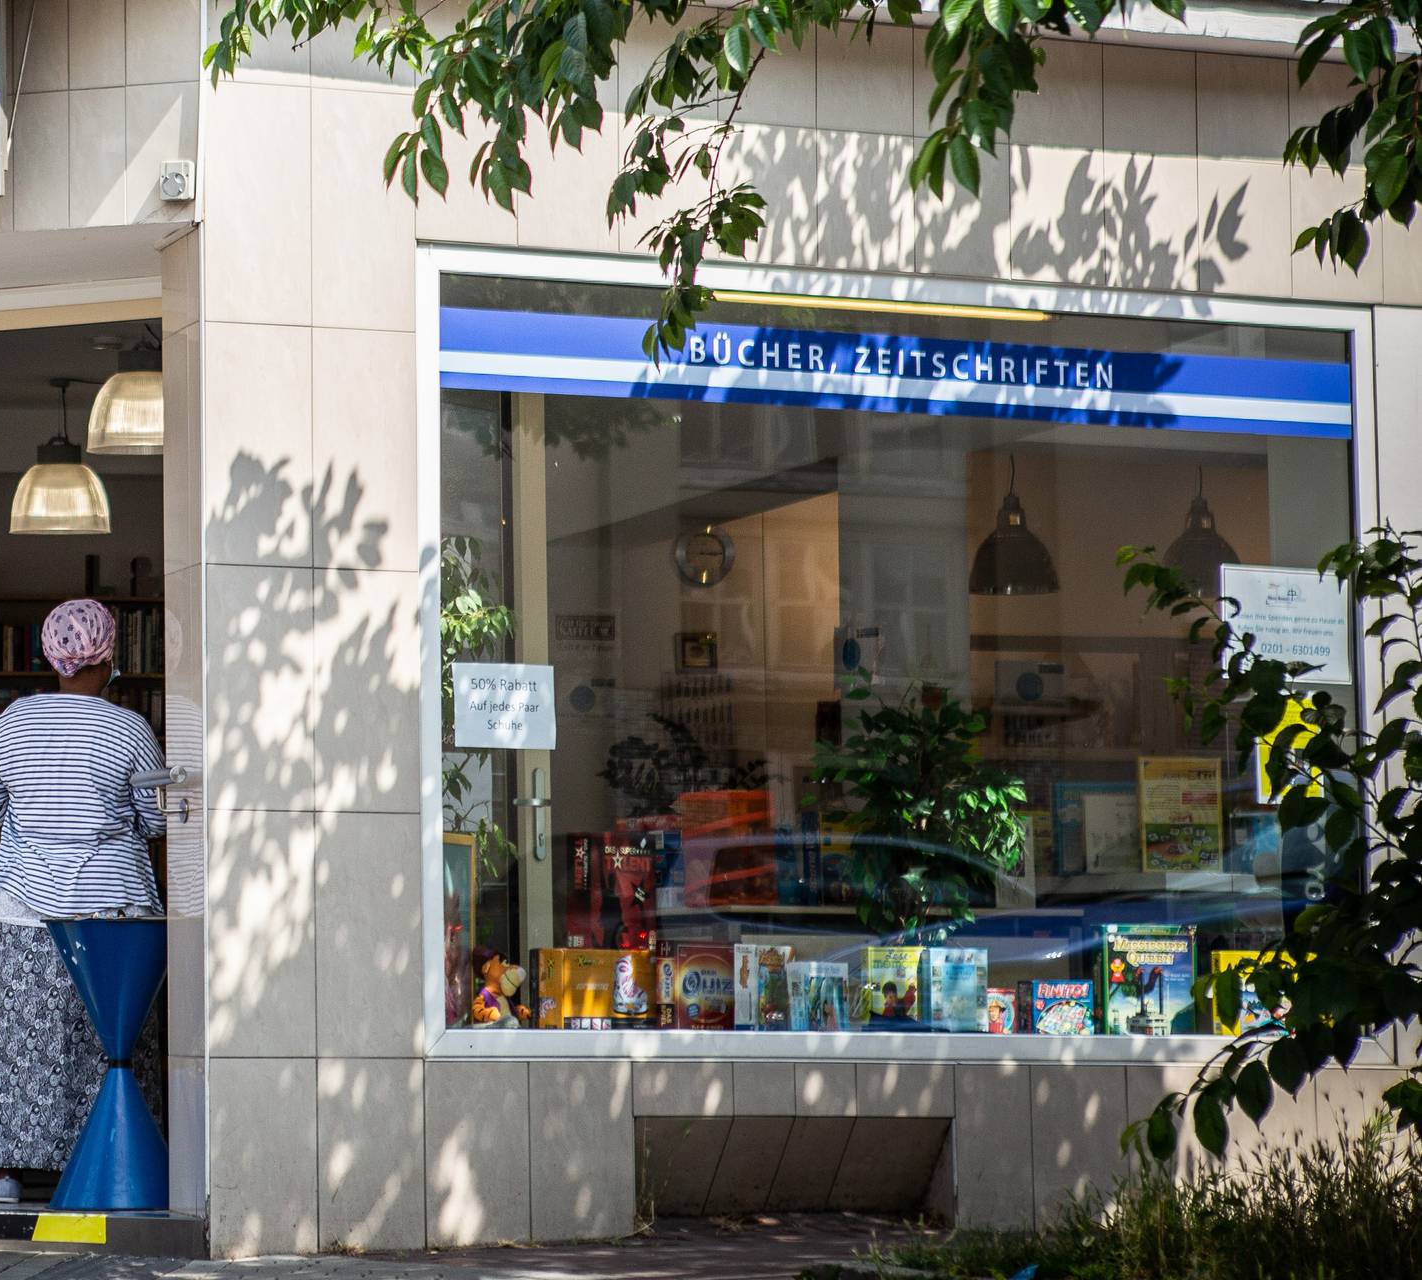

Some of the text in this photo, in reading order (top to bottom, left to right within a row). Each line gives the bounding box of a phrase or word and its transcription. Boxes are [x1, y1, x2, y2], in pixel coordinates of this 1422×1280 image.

[690, 331, 1114, 389] BÜCHER, ZEITSCHRIFTEN
[1261, 643, 1283, 655] 0201
[1292, 645, 1330, 657] 6301499
[470, 678, 537, 692] 50% Rabatt
[470, 700, 539, 714] Auf jedes Paar
[487, 720, 523, 731] Schuhe
[1113, 937, 1188, 953] MISSISSIPPI
[1126, 951, 1175, 968] QUEEN
[682, 971, 733, 998] QUIZ
[1037, 983, 1089, 999] FINITO!
